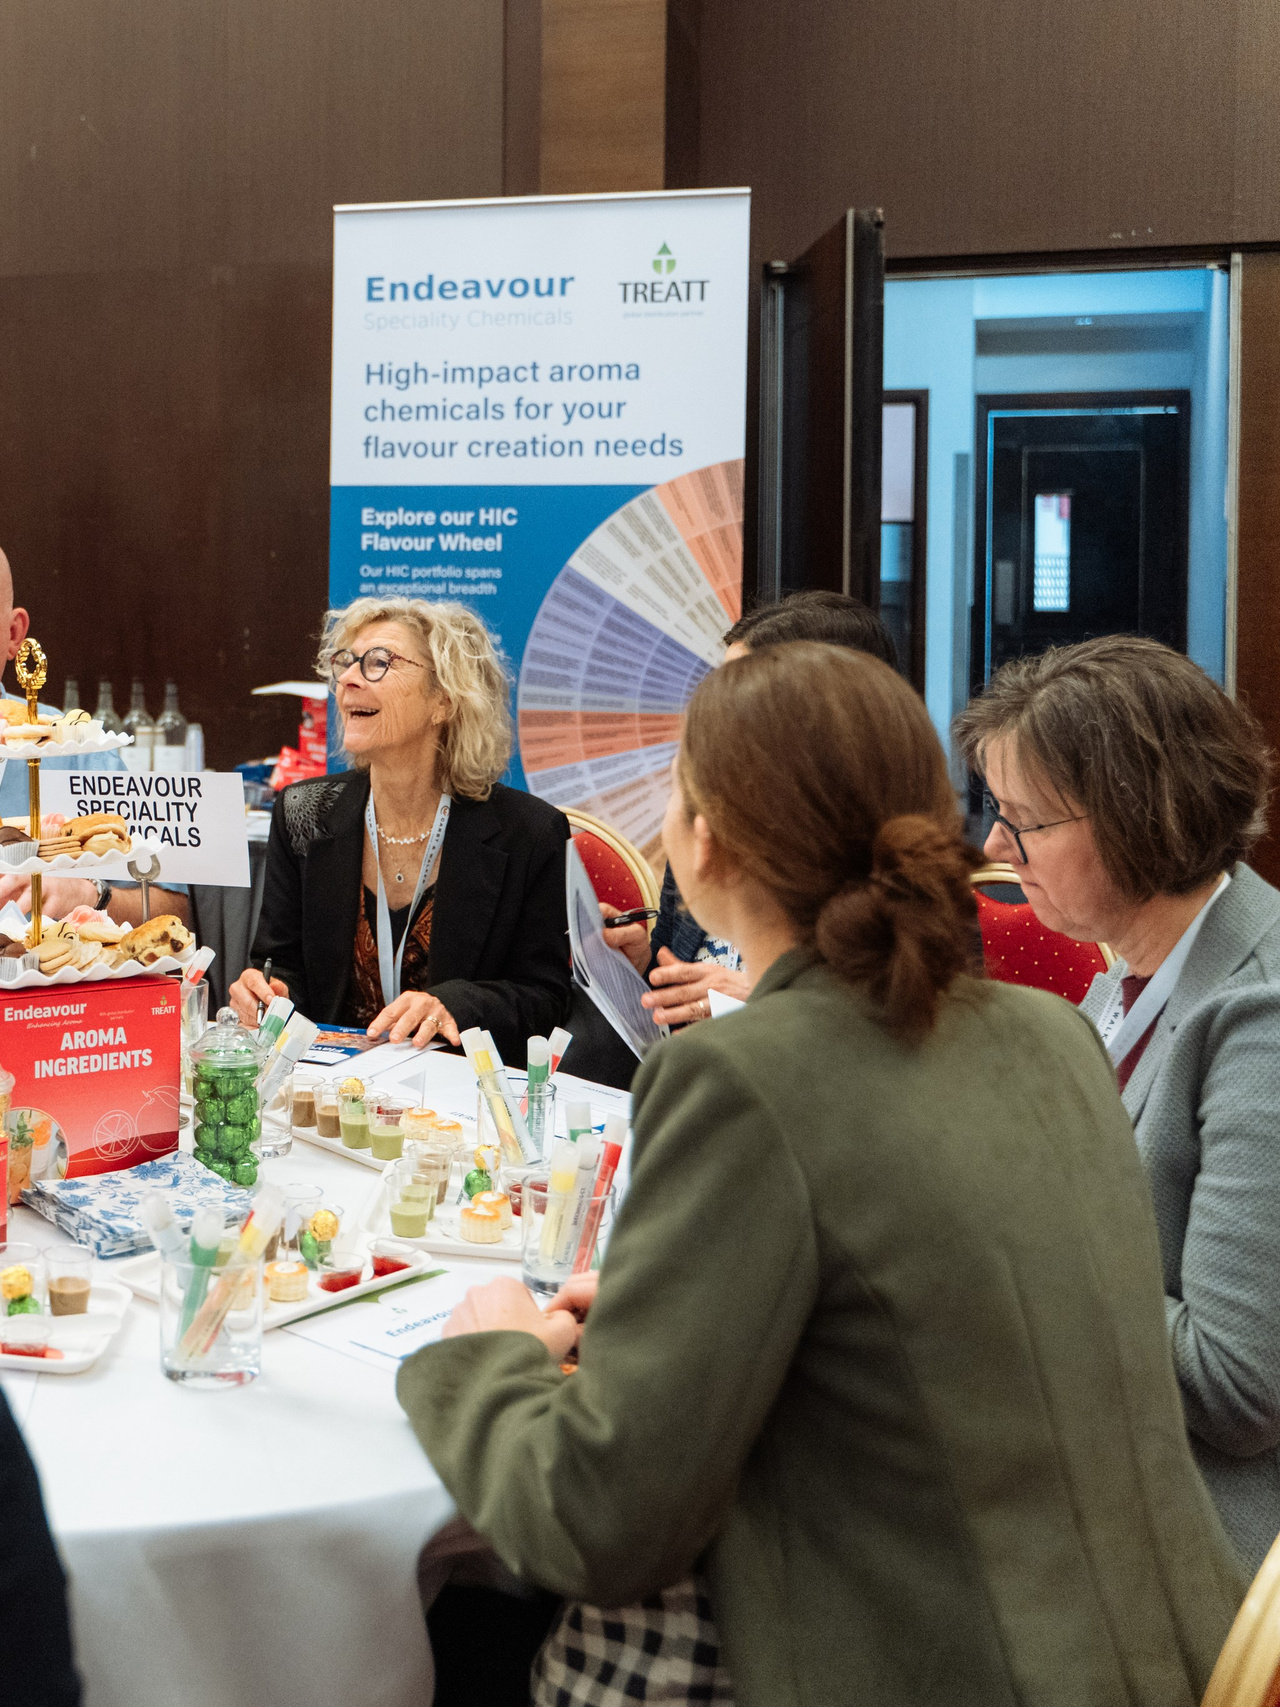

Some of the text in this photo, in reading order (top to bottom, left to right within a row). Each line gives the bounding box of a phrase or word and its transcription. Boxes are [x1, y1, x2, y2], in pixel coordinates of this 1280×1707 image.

[366, 274, 575, 302] Endeavour
[618, 280, 710, 303] TREATT
[363, 308, 573, 332] Speciality Chemicals
[365, 361, 641, 390] High-impact aroma
[364, 397, 626, 426] chemicals for your
[363, 433, 684, 458] flavour creation needs
[361, 507, 518, 530] Explore our HIC
[361, 532, 503, 551] Flavour Wheel
[359, 564, 503, 580] Our HIC portfolio spans
[359, 581, 498, 595] an exceptional breadth
[70, 775, 203, 798] ENDEAVOUR
[76, 799, 198, 822] SPECIALITY
[4, 1003, 87, 1022] Endeavour
[151, 1005, 176, 1016] TREATT
[26, 1019, 61, 1030] Enhancing
[60, 1026, 128, 1051] AROMA
[34, 1048, 153, 1079] INGREDIENTS
[385, 1309, 452, 1337] Endeavou
